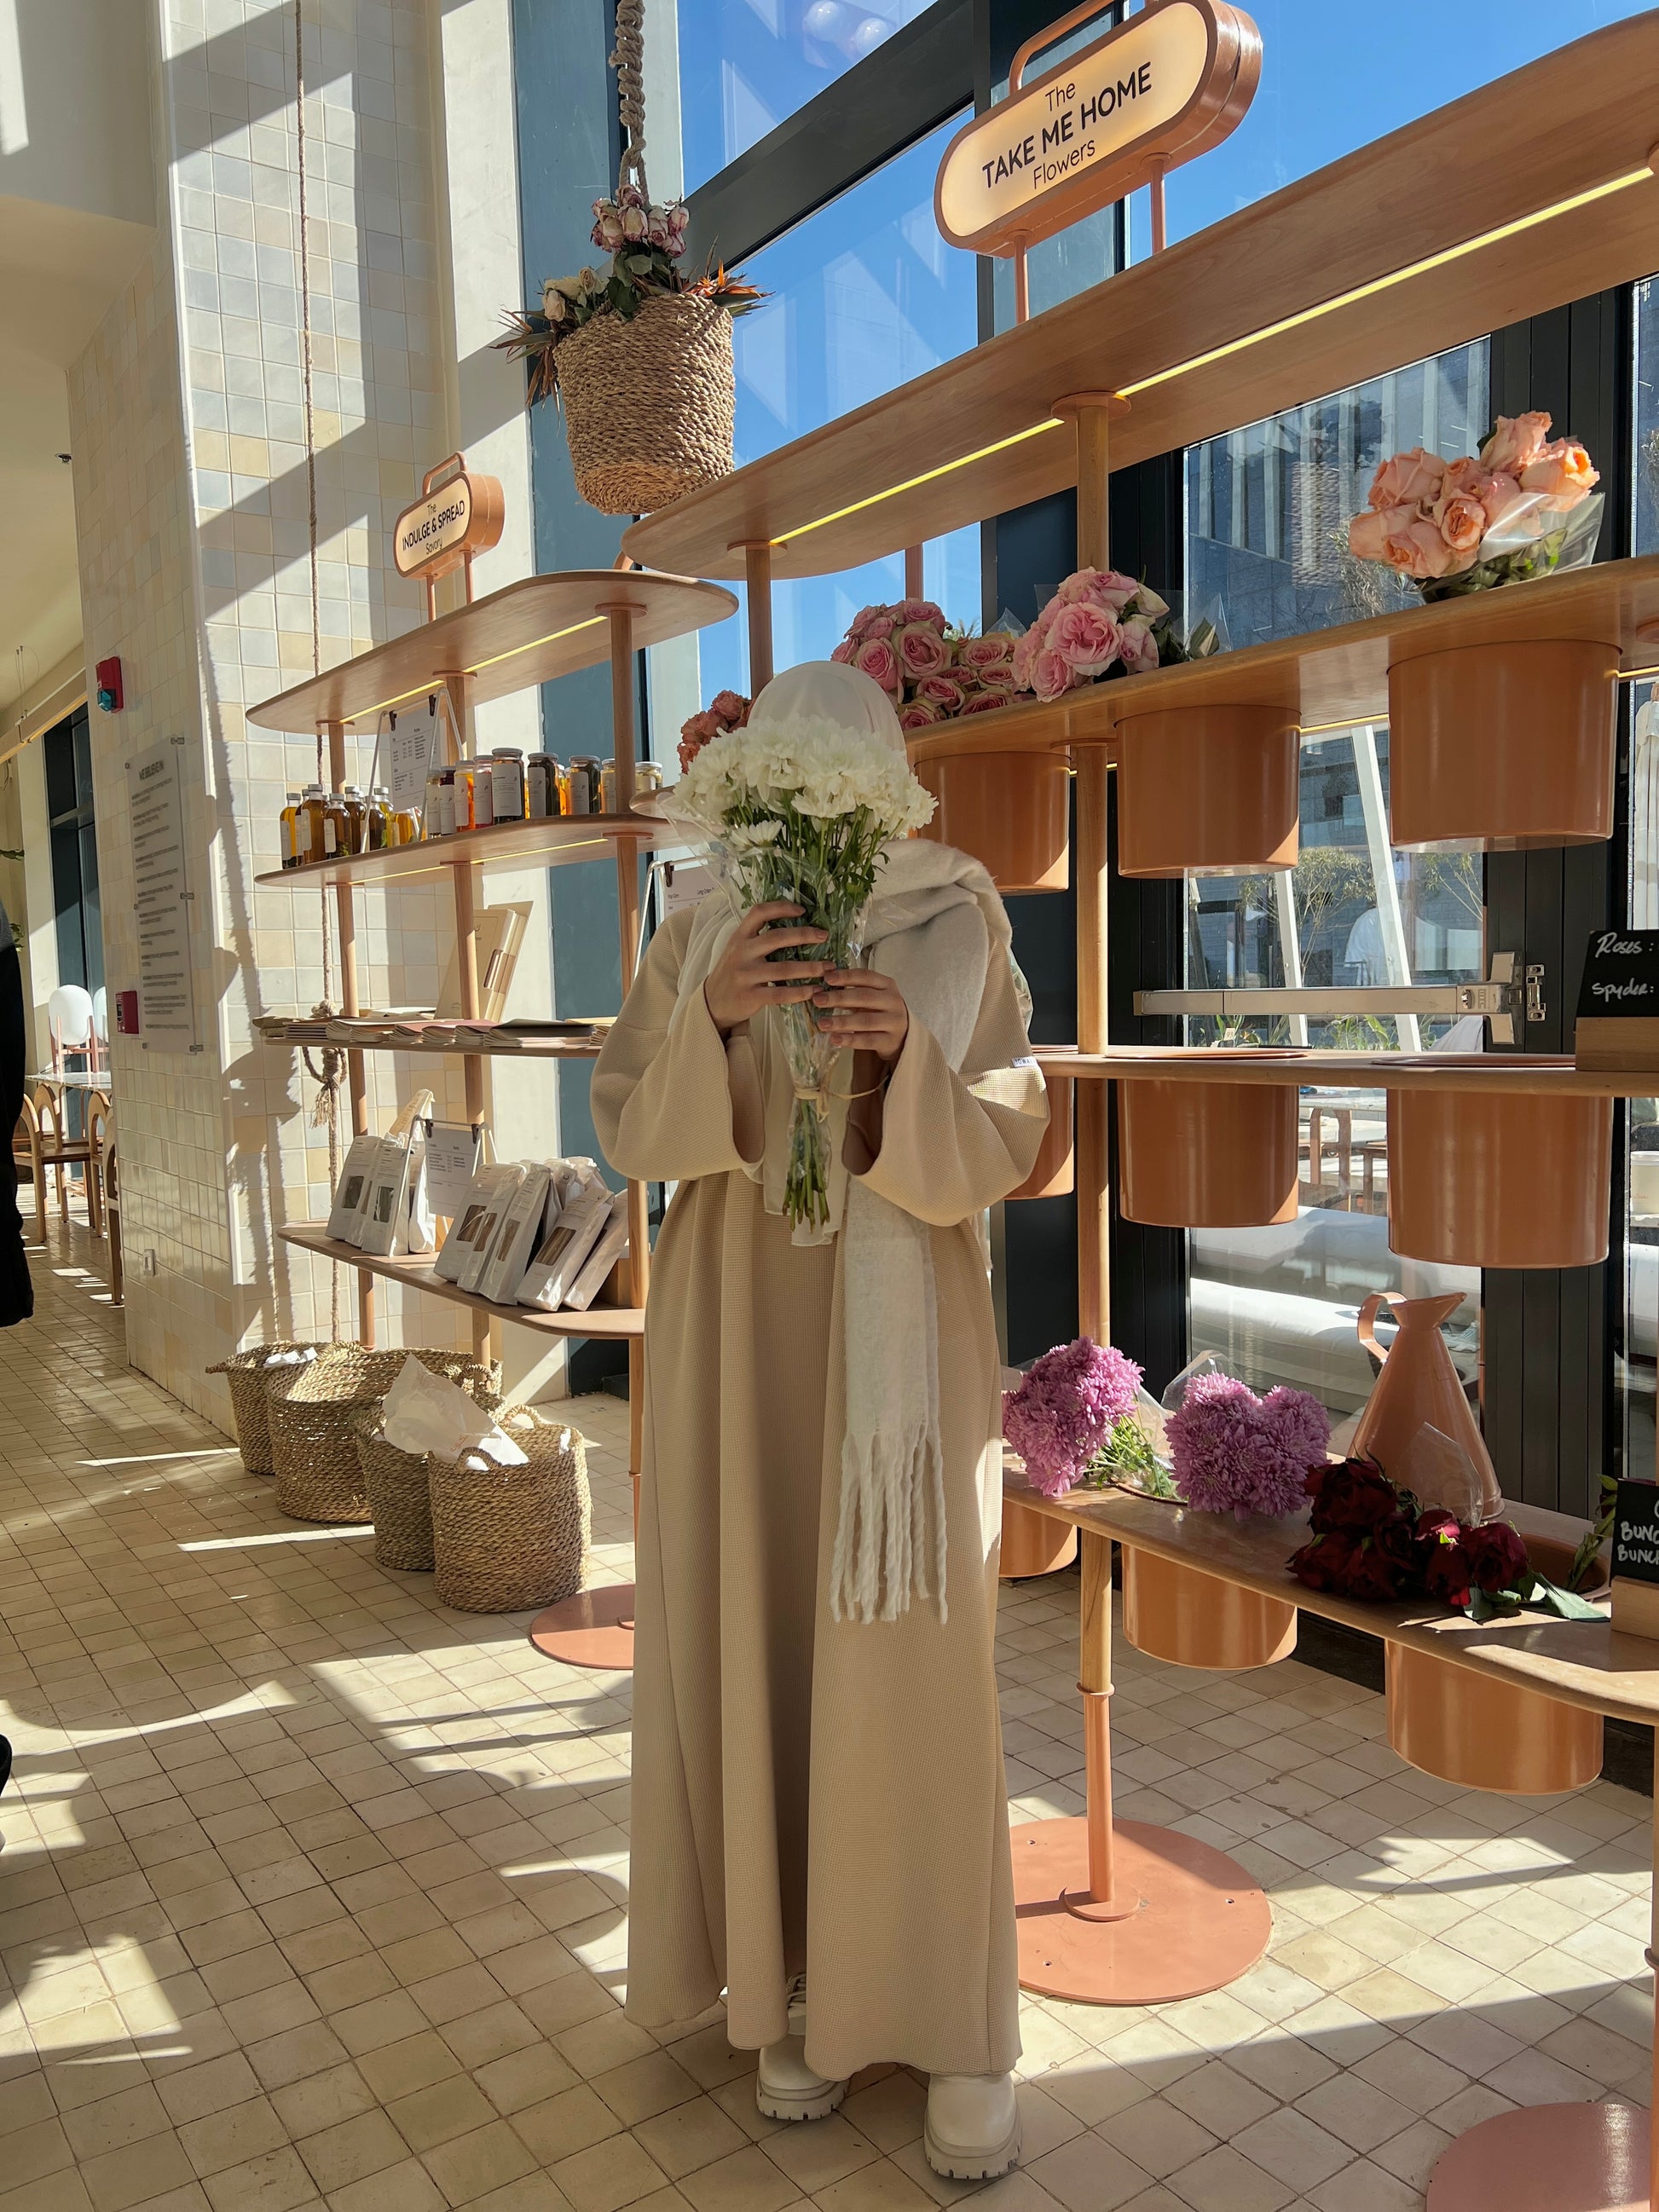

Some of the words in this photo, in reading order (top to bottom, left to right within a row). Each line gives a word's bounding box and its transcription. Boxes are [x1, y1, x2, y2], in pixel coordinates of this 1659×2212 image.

[1045, 82, 1076, 112] The
[982, 135, 1036, 188] TAKE
[1042, 112, 1074, 154] ME
[1080, 61, 1152, 130] HOME
[1032, 139, 1095, 190] Flowers
[402, 522, 431, 552] INDULGE
[431, 519, 437, 533] &
[437, 500, 465, 529] SPREAD
[427, 504, 436, 516] The
[425, 537, 443, 555] Savory
